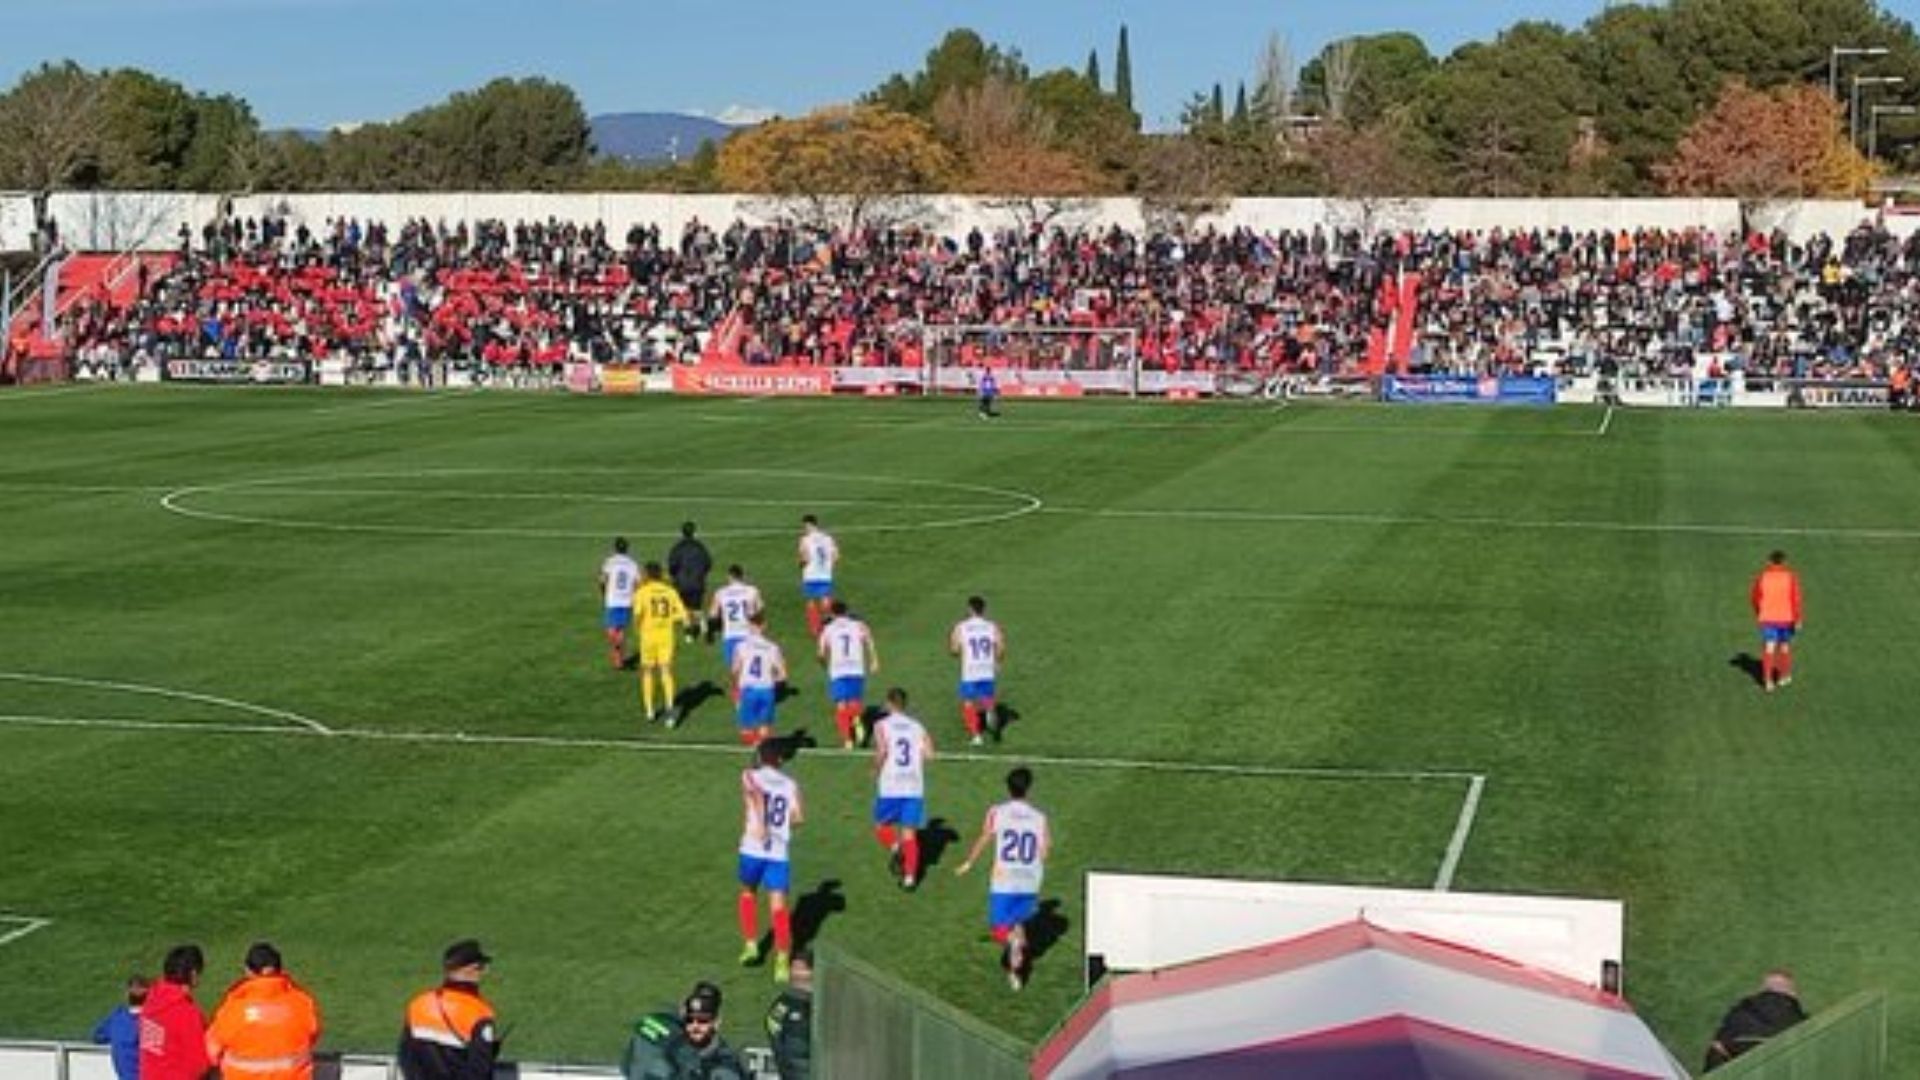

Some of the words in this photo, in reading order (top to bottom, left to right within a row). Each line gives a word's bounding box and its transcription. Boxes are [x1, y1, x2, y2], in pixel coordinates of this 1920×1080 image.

[650, 598, 670, 618] 13
[727, 600, 748, 621] 21
[969, 637, 991, 660] 19
[749, 656, 762, 679] 4
[896, 738, 911, 767] 3
[763, 794, 787, 827] 18
[1001, 829, 1037, 864] 20
